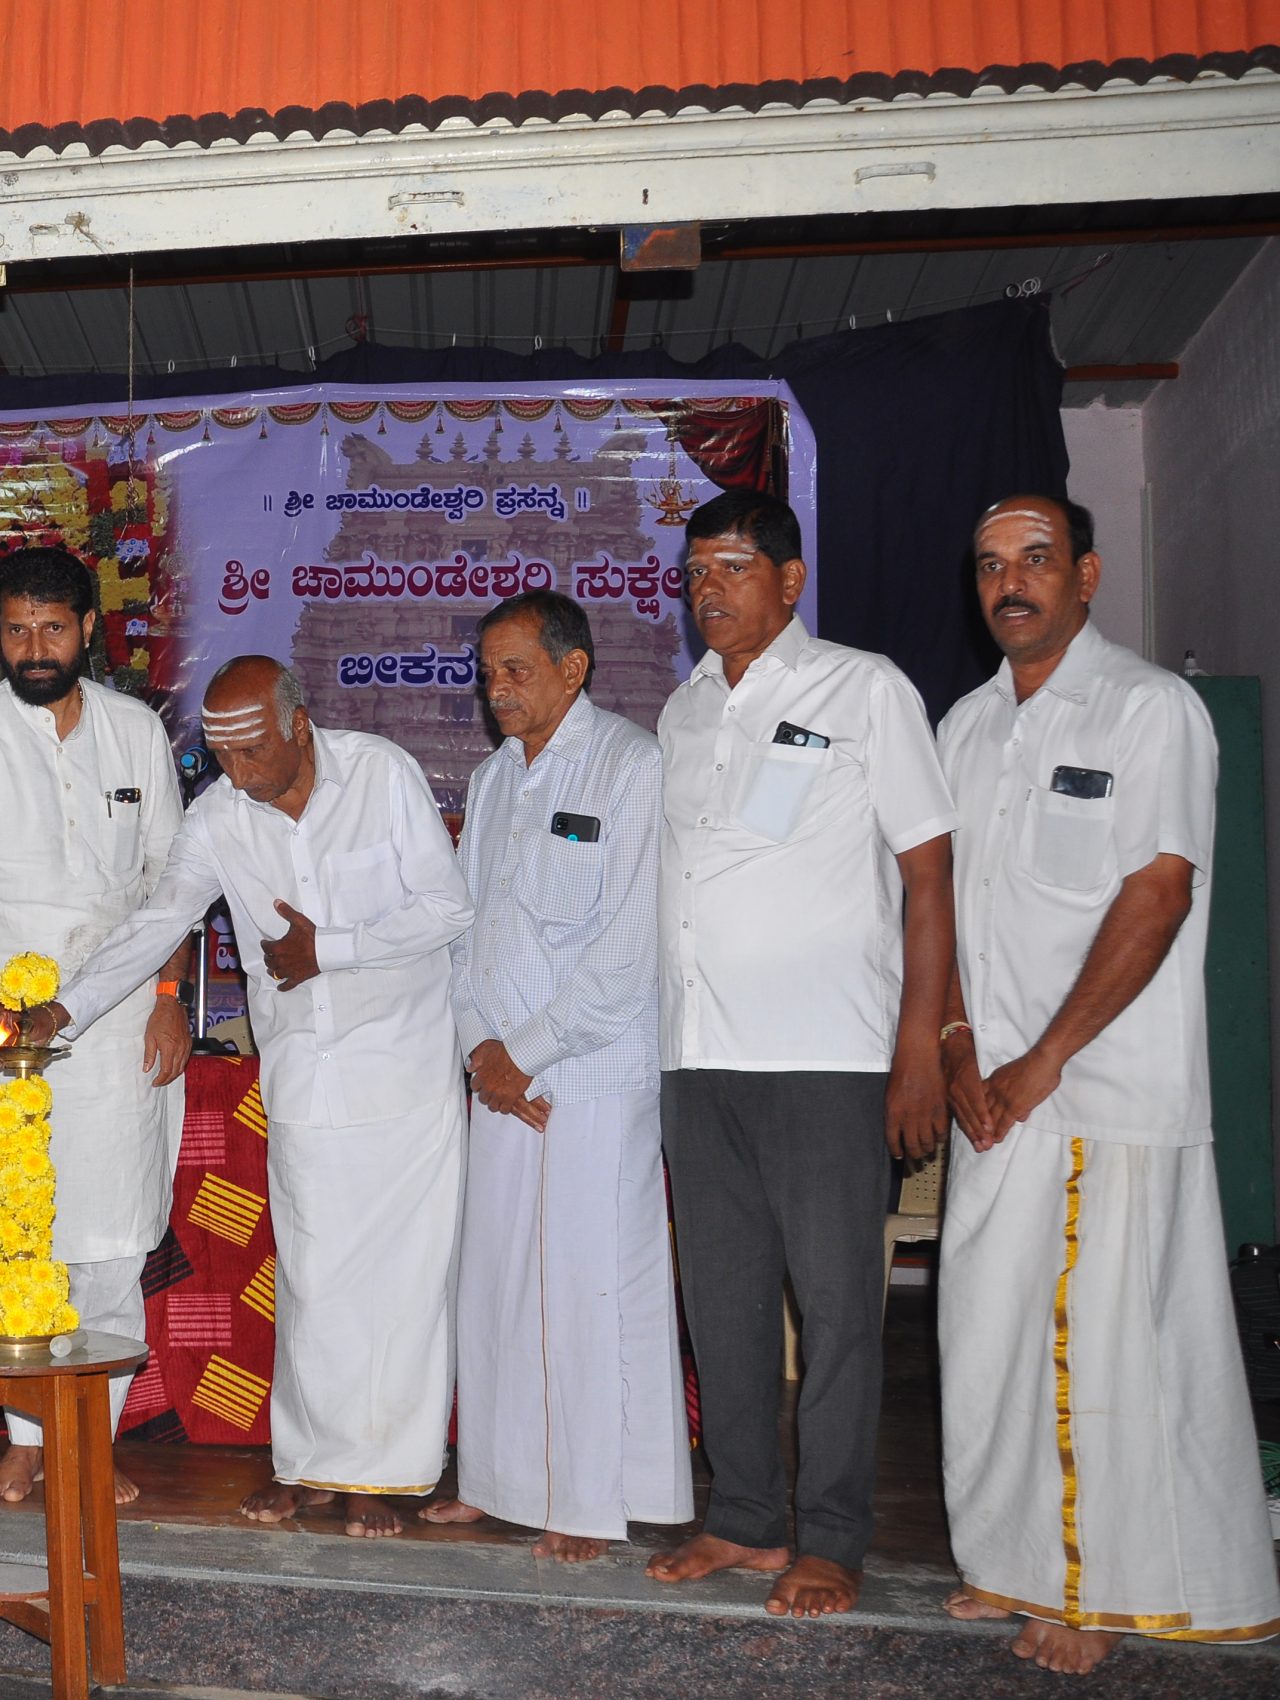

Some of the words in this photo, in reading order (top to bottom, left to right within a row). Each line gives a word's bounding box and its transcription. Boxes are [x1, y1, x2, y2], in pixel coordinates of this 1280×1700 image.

[284, 490, 314, 518] ಶ್ರೀ
[325, 487, 484, 520] ಚಾಮುಂಡೇಶ್ವರಿ
[496, 486, 564, 519] ಪ್ರಸನ್ನ
[219, 560, 270, 615] ಶ್ರೀ
[576, 555, 682, 619] ಸುಕ್ಷೇ
[340, 646, 485, 685] ಬೀಕನ
